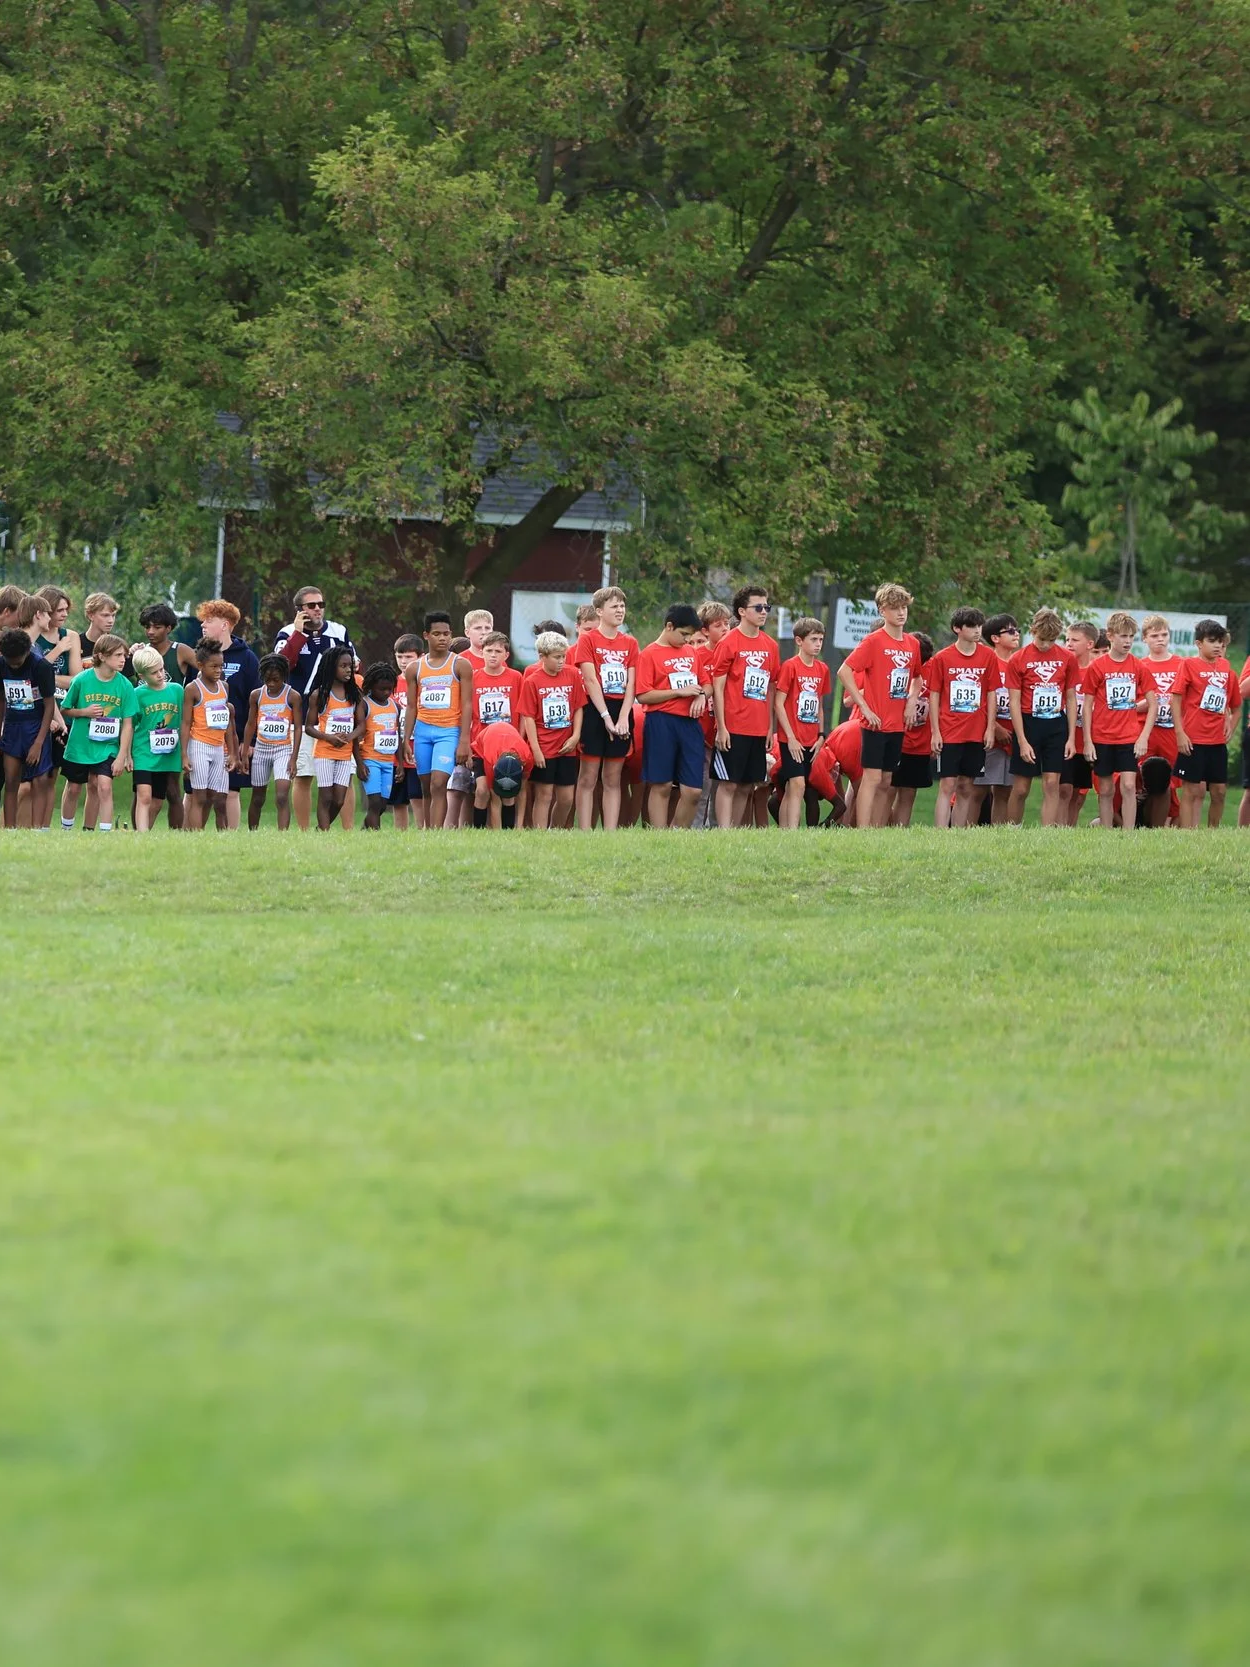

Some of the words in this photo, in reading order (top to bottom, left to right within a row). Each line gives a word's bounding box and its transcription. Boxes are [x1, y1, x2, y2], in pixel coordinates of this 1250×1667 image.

[596, 647, 629, 656] SMART
[884, 649, 913, 658] SMART
[664, 657, 695, 666] SMART
[1026, 661, 1063, 669] SMART
[948, 667, 986, 675] SMART
[607, 671, 625, 682] 610
[750, 675, 765, 688] 612
[9, 687, 27, 699] 691
[476, 686, 513, 694] SMART
[538, 685, 574, 694] SMART
[956, 688, 976, 700] 635
[1112, 686, 1131, 698] 627
[85, 693, 121, 706] PIERCE
[425, 692, 445, 701] 2087
[1039, 695, 1057, 707] 615
[145, 703, 179, 715] PIERCE
[485, 701, 504, 713] 617
[549, 704, 567, 717] 638
[95, 725, 116, 734] 2080
[263, 723, 285, 733] 2089
[155, 737, 175, 746] 2079
